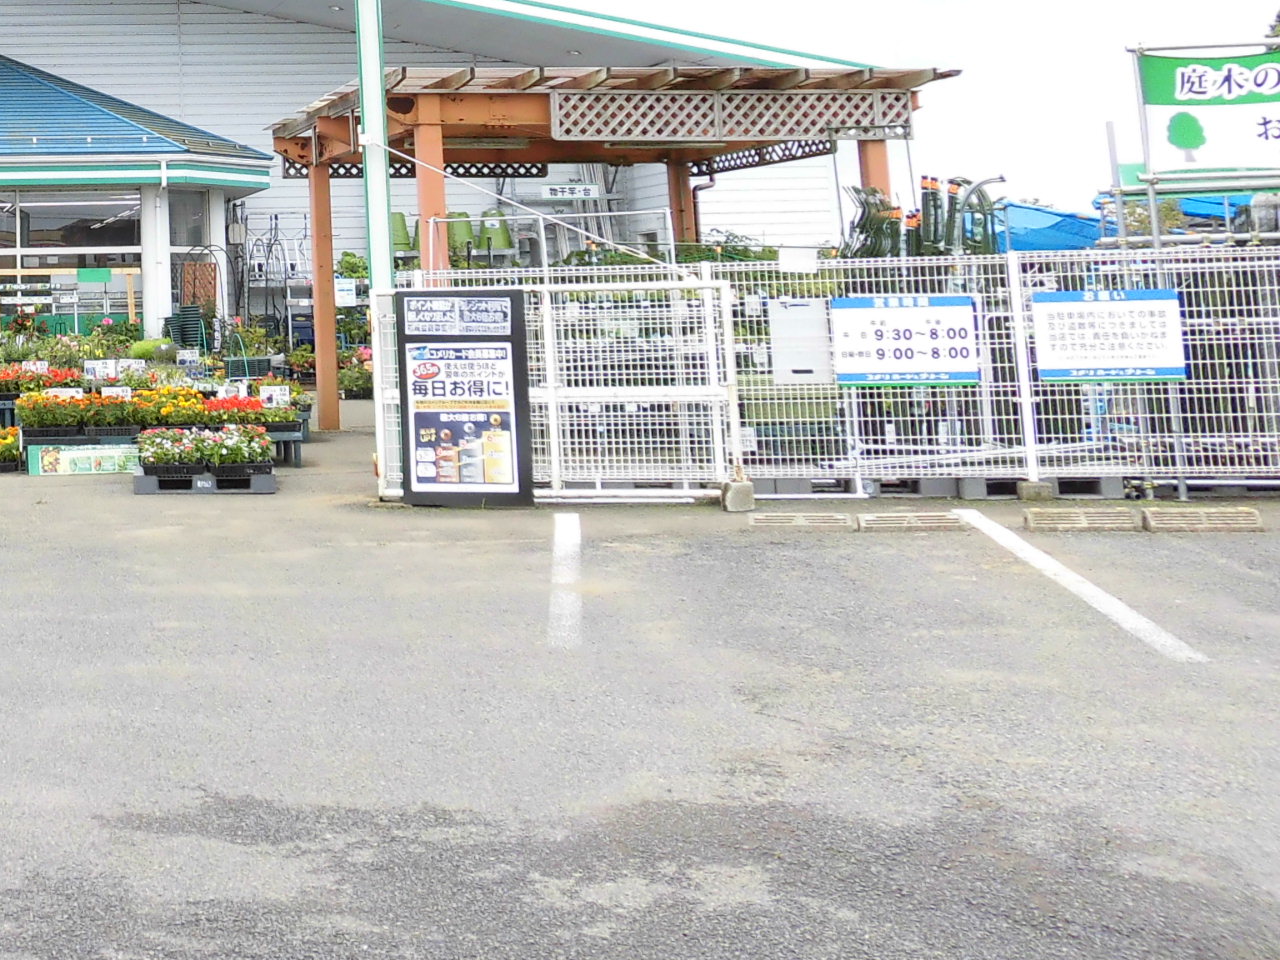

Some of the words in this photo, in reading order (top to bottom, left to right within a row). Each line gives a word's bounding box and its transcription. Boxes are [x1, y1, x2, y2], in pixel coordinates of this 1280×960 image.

[1179, 66, 1280, 95] 庭木の
[411, 380, 510, 398] 毎日お得に!
